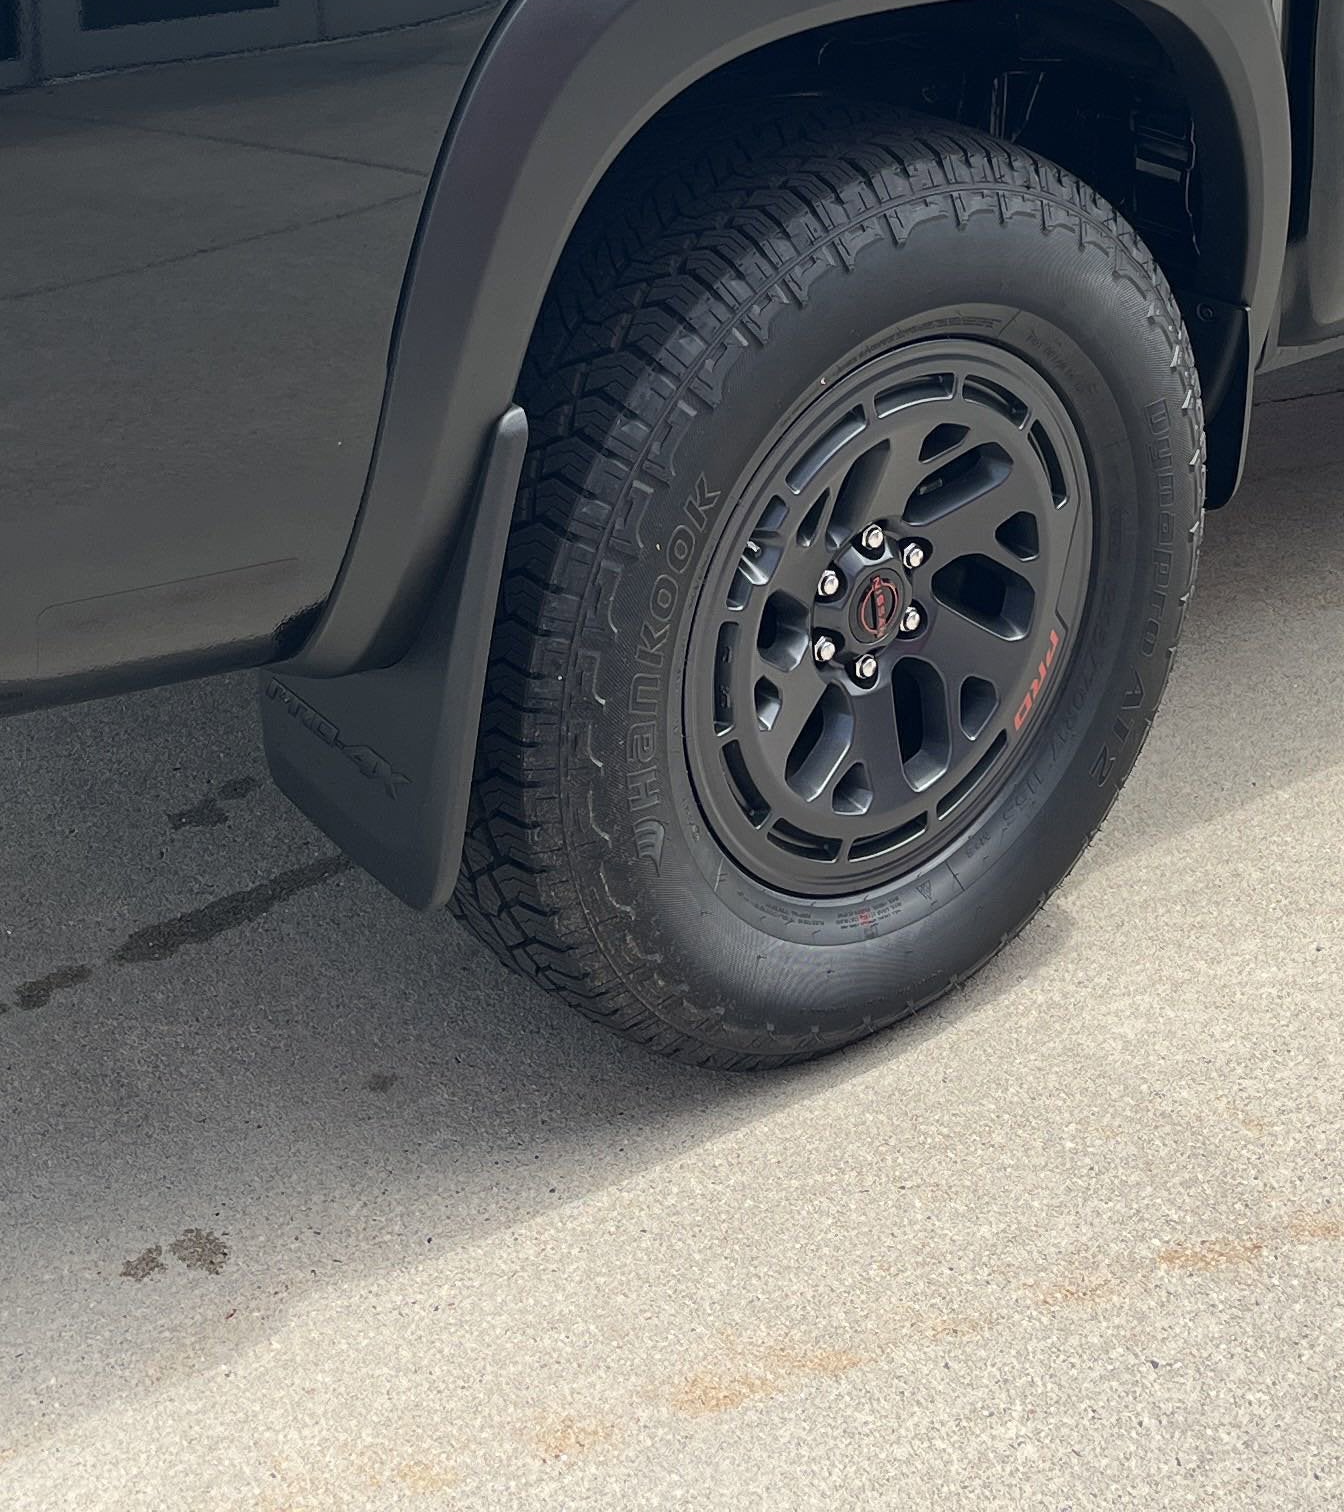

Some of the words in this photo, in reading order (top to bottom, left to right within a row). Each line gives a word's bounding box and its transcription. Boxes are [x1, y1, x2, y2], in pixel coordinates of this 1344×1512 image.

[625, 470, 722, 813] Hankook
[1137, 397, 1175, 659] Dynapro
[1014, 630, 1060, 731] PRO
